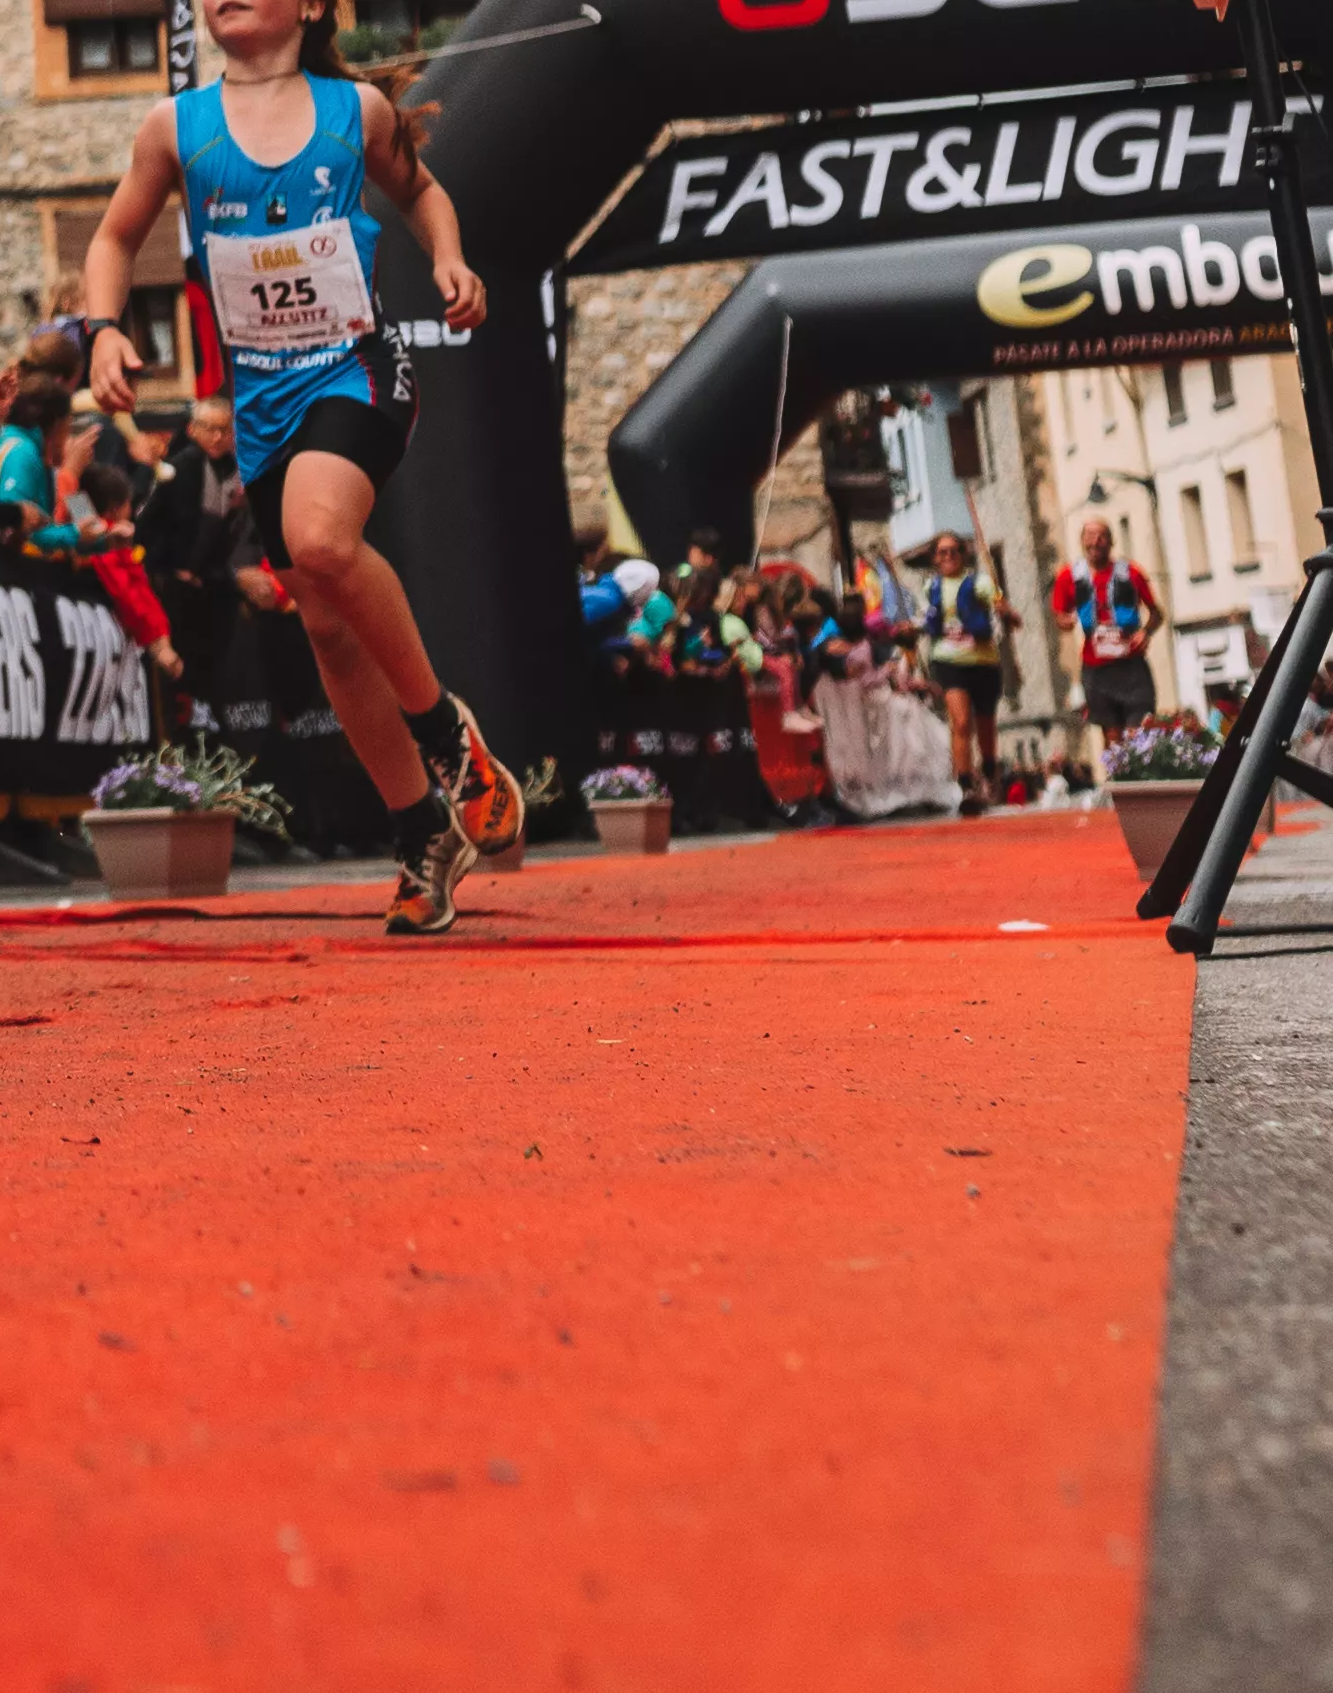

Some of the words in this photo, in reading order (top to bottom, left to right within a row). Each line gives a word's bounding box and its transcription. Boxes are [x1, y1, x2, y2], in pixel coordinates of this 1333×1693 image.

[659, 95, 1324, 244] FAST&LIGH
[251, 276, 318, 311] 125
[1067, 337, 1080, 360] A
[1111, 326, 1235, 362] OPERADORA
